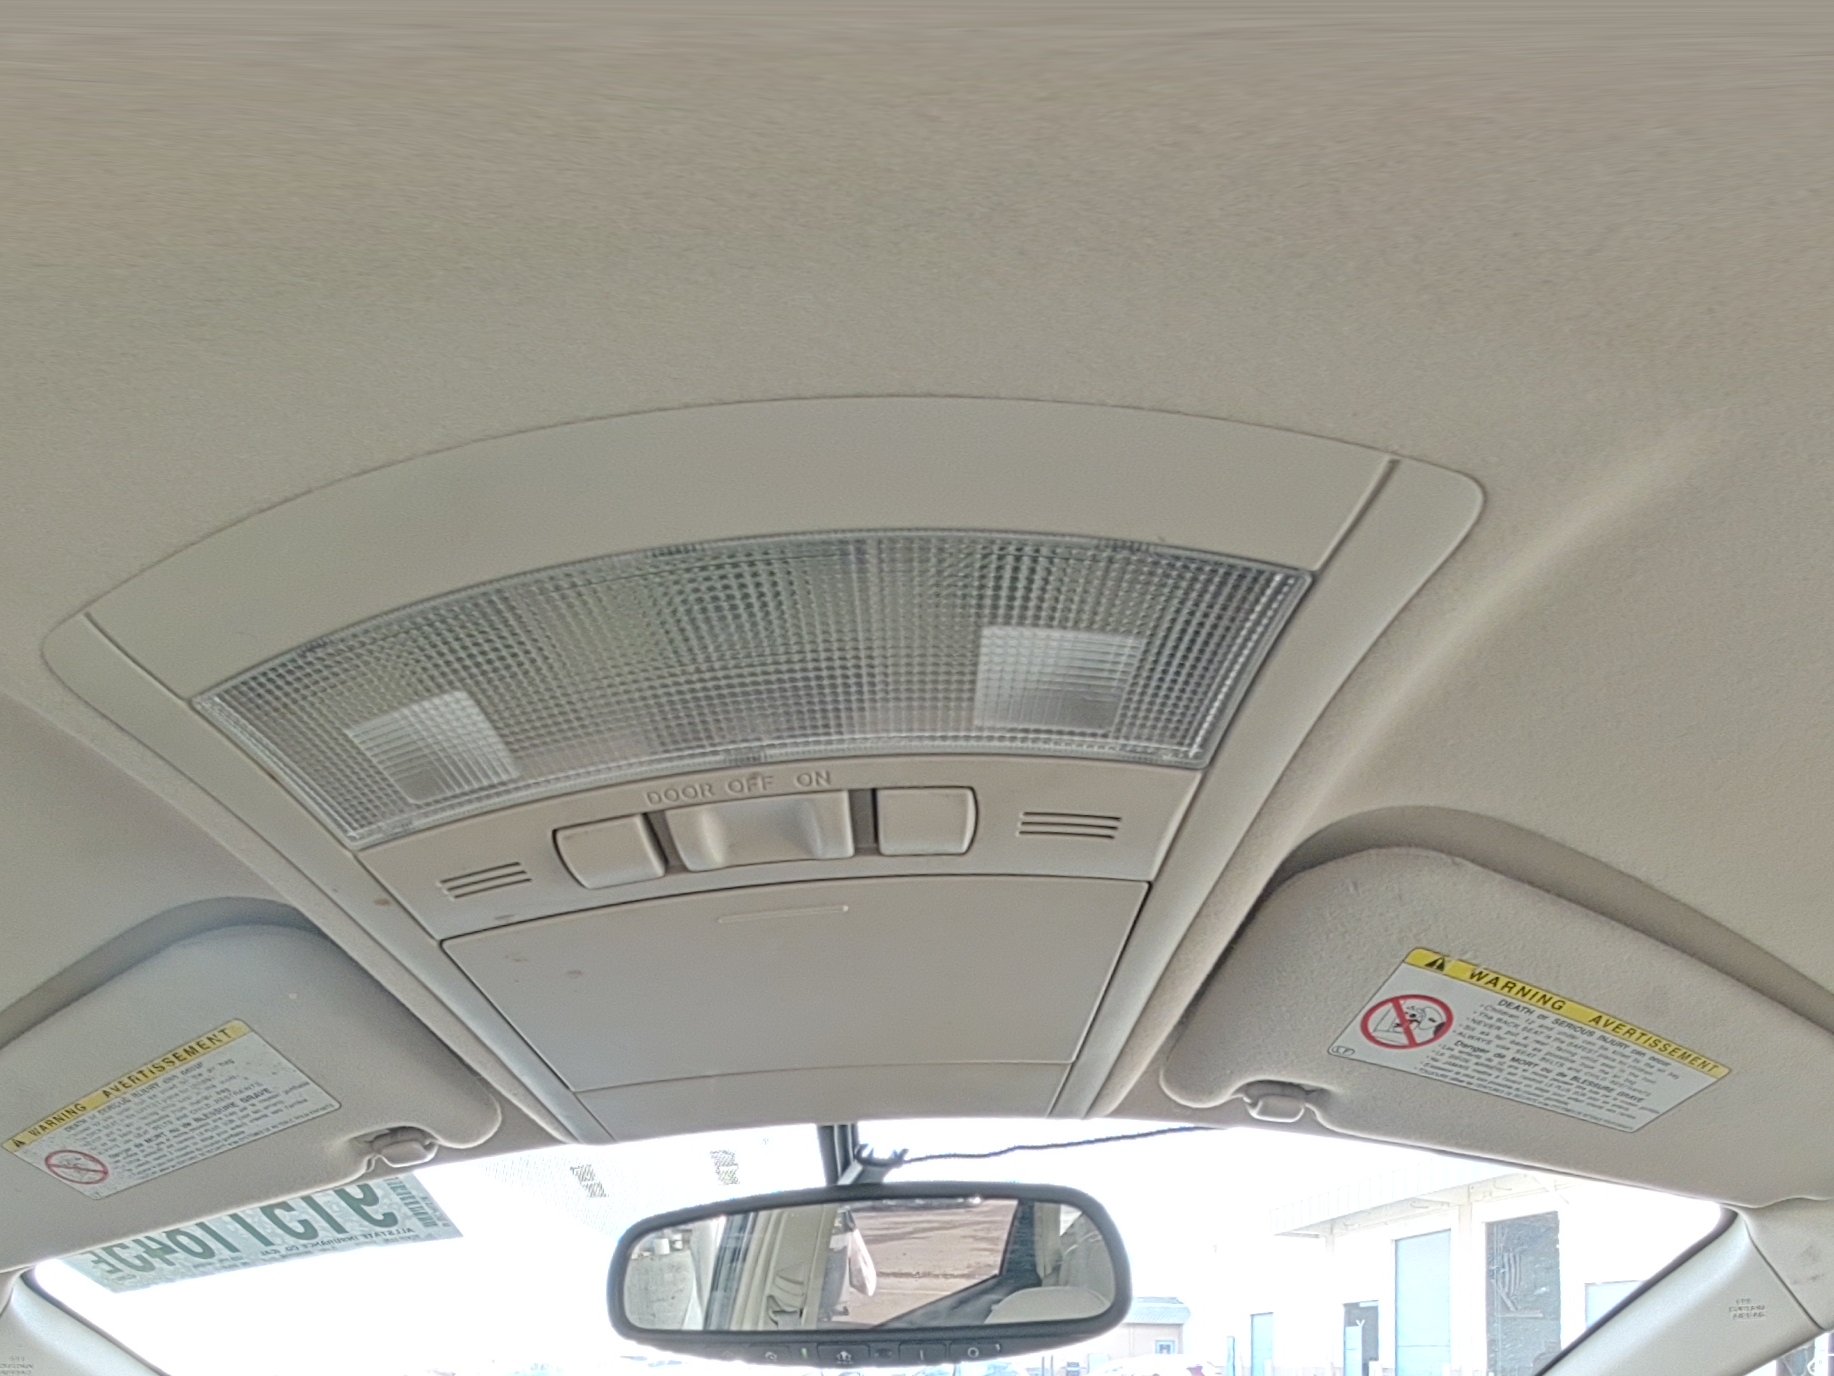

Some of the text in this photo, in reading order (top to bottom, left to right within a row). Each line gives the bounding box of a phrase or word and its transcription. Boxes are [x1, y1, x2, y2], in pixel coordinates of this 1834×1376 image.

[645, 770, 832, 806] DOOR OFF ON
[1465, 966, 1721, 1074] WARNING AVERTISSEMENT
[1496, 997, 1536, 1017] DEATH
[1549, 1017, 1597, 1038] SERIOUS
[1594, 1033, 1632, 1051] INJURY
[25, 1101, 89, 1137] WARNING
[100, 1026, 234, 1100] AVERTISSEMENT
[1507, 1055, 1539, 1069] MORT
